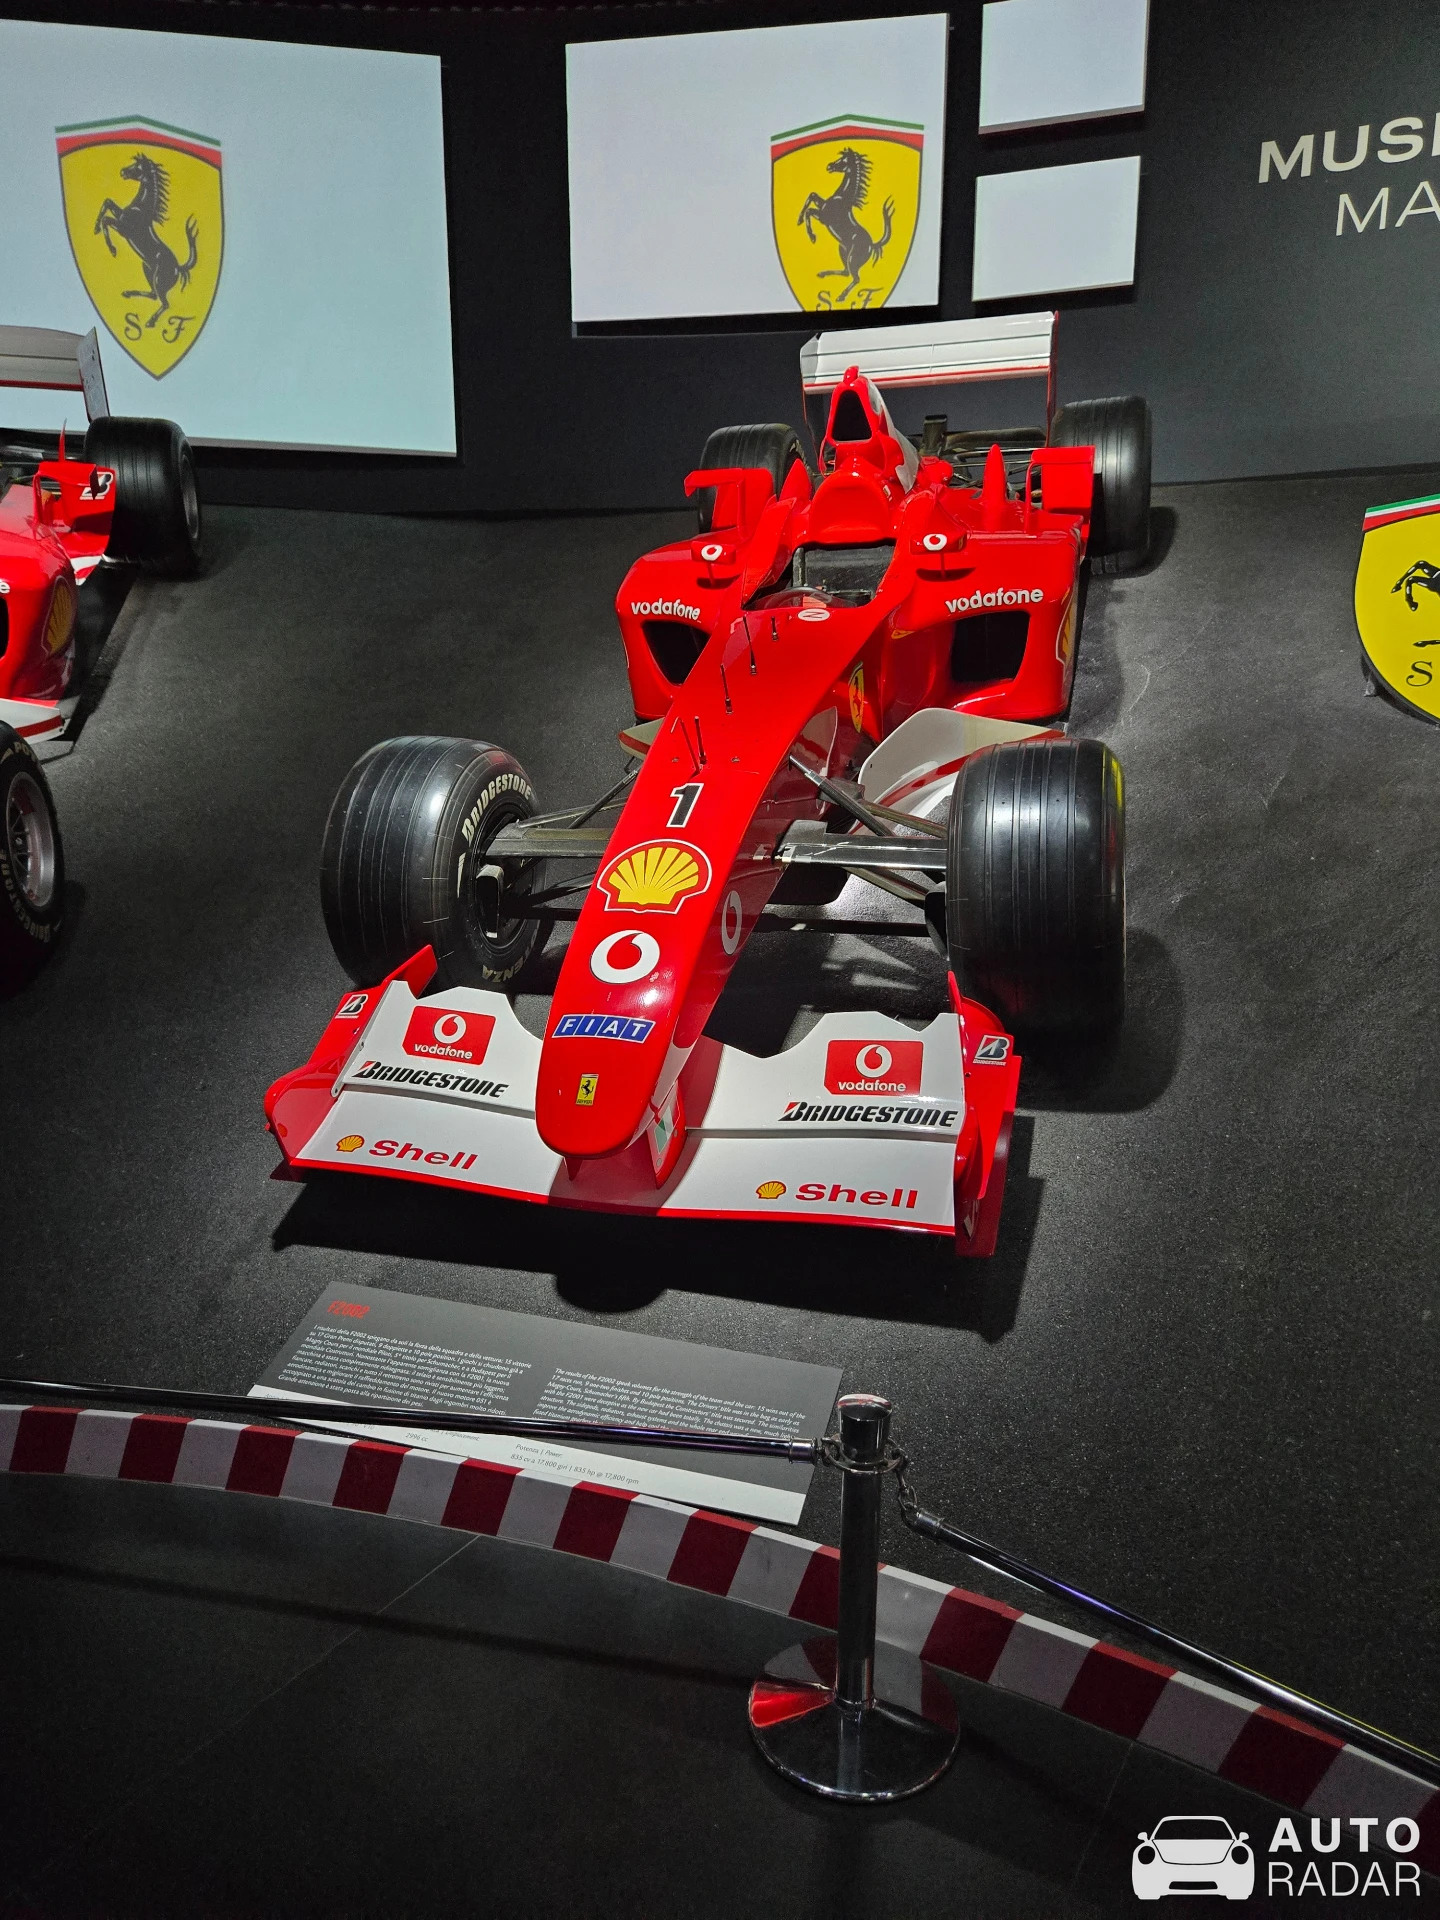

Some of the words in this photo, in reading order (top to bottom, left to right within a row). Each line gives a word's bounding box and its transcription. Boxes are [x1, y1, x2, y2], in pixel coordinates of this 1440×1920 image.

[124, 312, 142, 341] S
[631, 598, 701, 620] vodafone
[944, 587, 1044, 613] vodafone
[461, 773, 532, 848] BRIDGESTONE
[666, 782, 704, 828] 1
[561, 1018, 647, 1037] FIAT
[414, 1043, 473, 1060] vodafone
[352, 1060, 510, 1098] BRIDGESTONE
[838, 1080, 906, 1092] vodafone
[778, 1101, 958, 1127] BRIDGESTONE
[369, 1140, 478, 1170] Shell
[795, 1183, 918, 1209] Shell
[326, 1300, 371, 1319] F2002
[405, 1432, 421, 1440] 2996
[515, 1444, 539, 1454] Potenza
